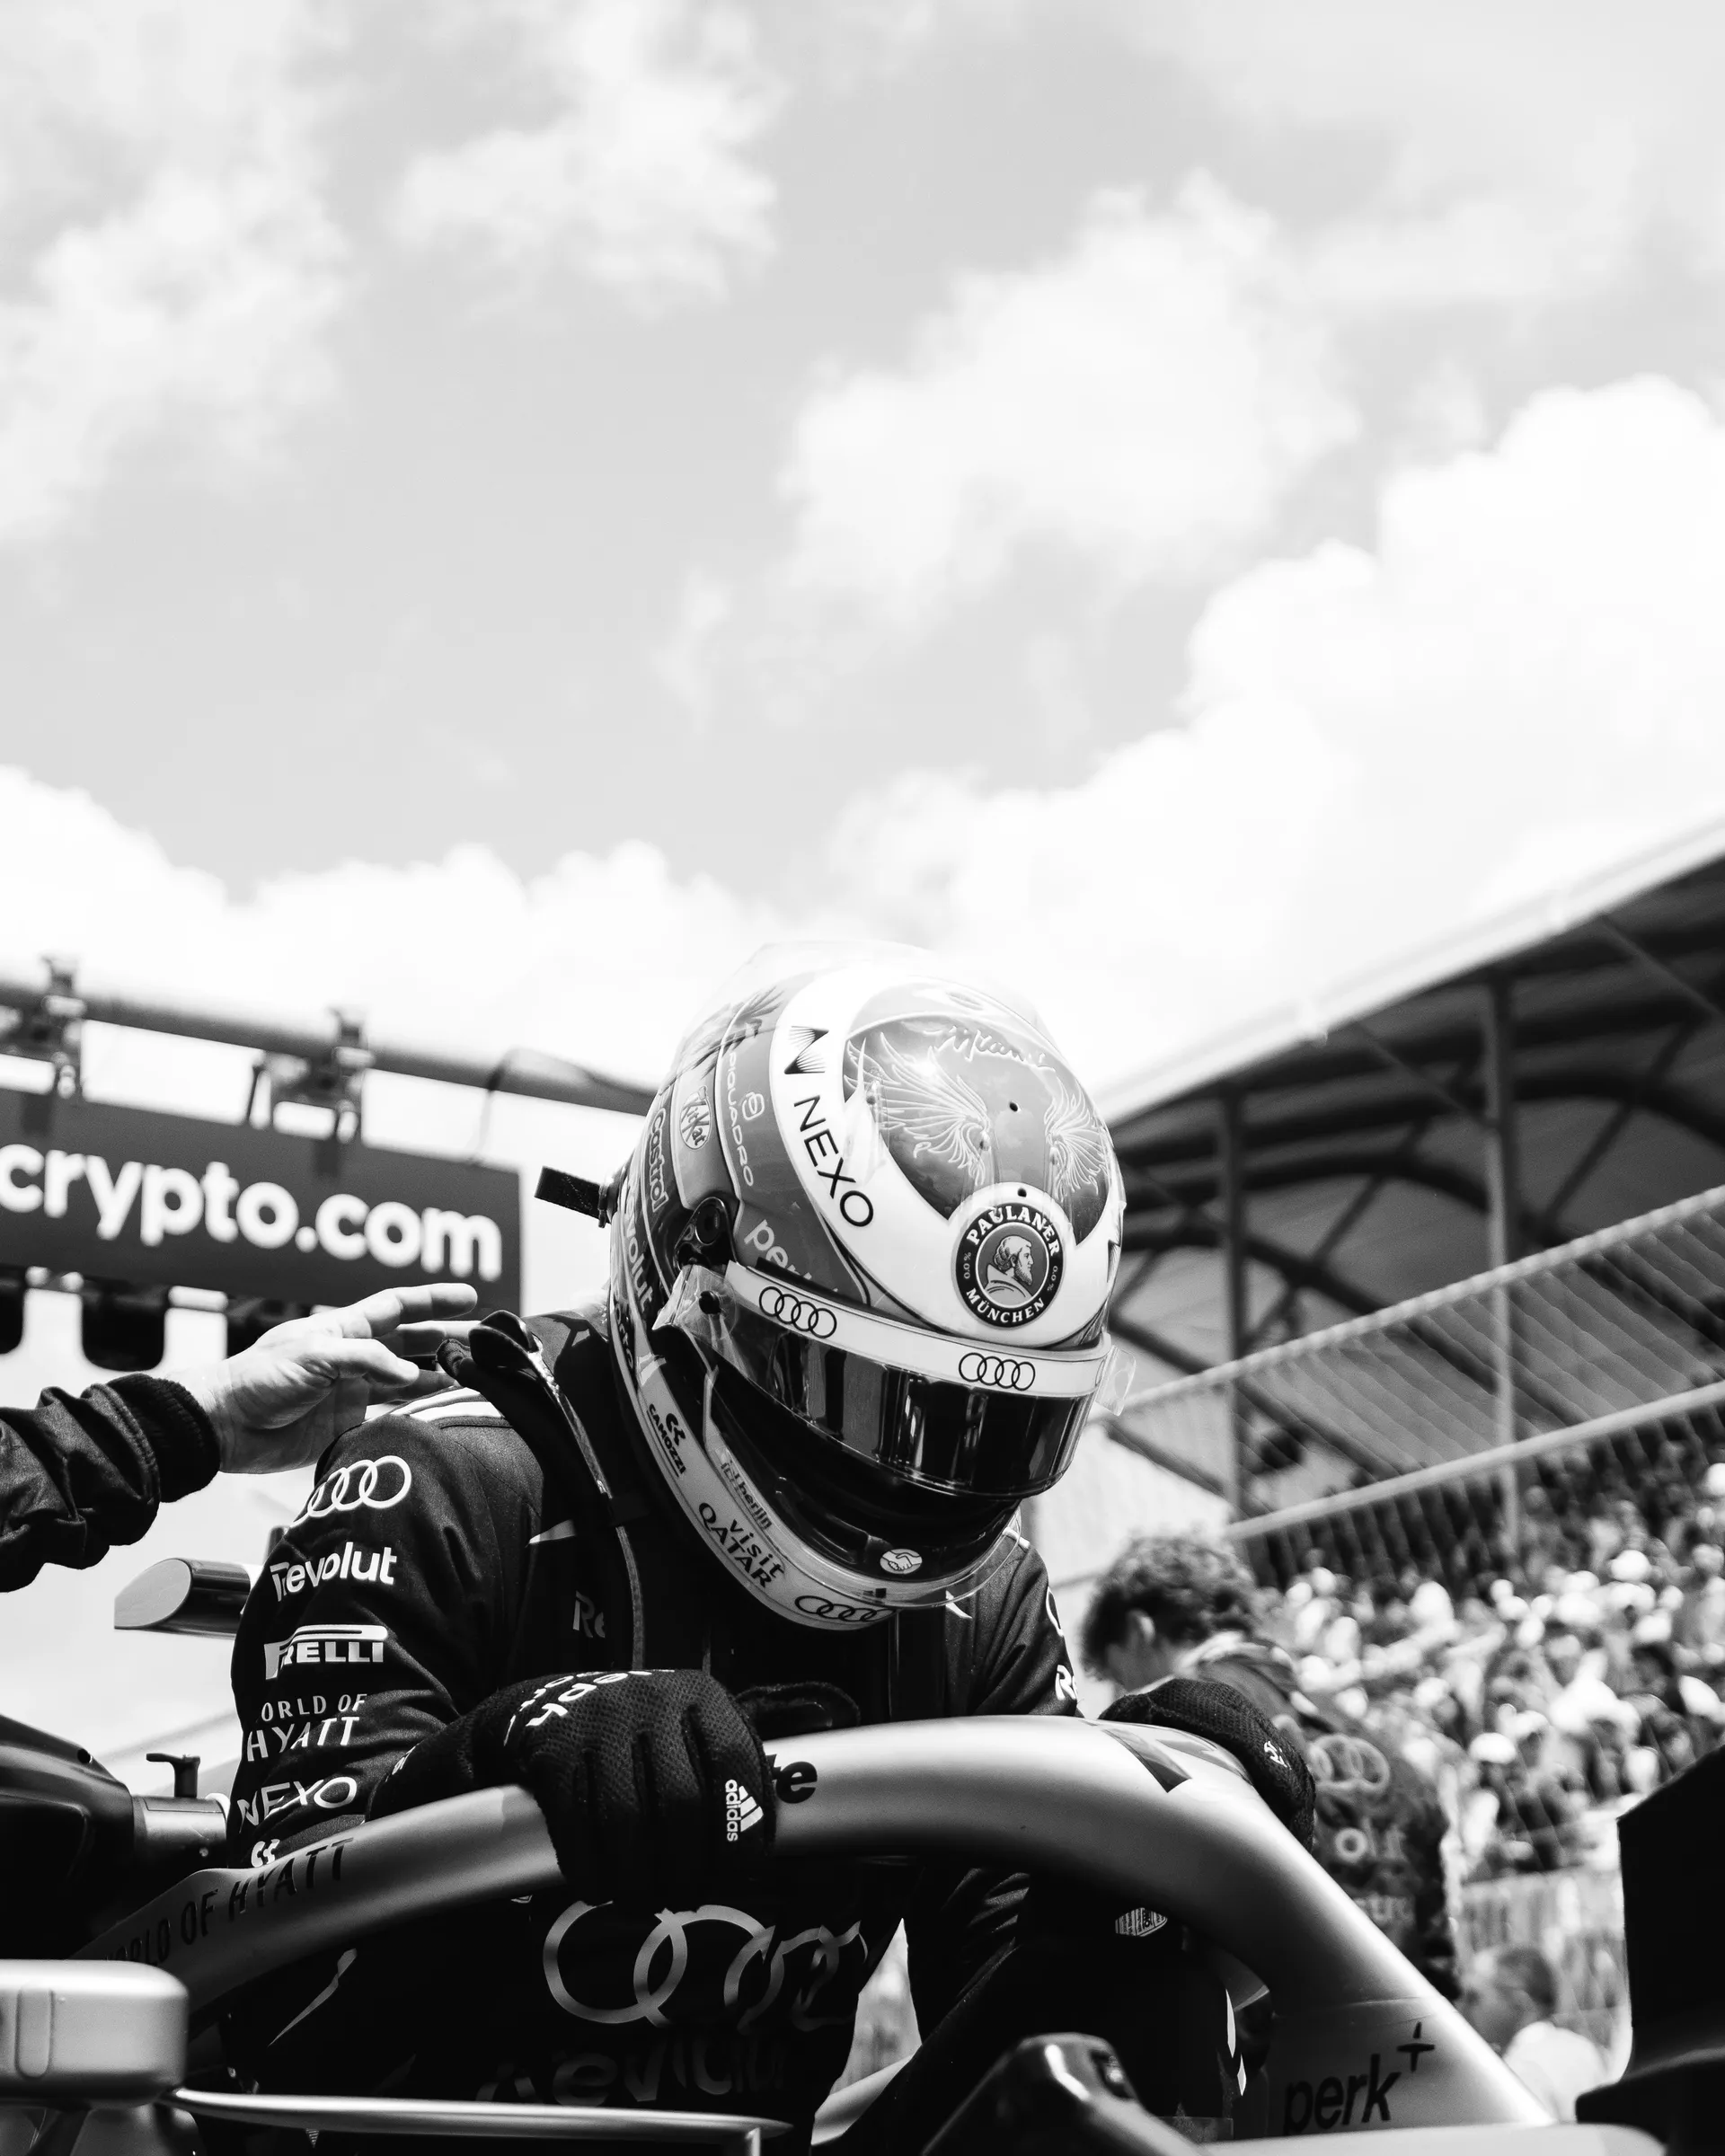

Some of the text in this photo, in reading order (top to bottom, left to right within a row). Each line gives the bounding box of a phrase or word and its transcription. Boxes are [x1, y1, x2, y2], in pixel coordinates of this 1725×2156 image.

[646, 1108, 669, 1213] Castrol
[793, 1094, 874, 1227] NEXO
[0, 1144, 503, 1282] crypto.com
[966, 1205, 1062, 1257] PAULANER
[966, 1286, 1046, 1324] MÜNCHEN
[649, 1403, 686, 1474] CAMOZZI
[698, 1502, 773, 1588] QATAR
[730, 1518, 785, 1578] visit
[263, 1624, 388, 1680] PRELLI
[261, 1693, 367, 1722] ORLD OF
[247, 1716, 360, 1762] HYATT
[237, 1776, 358, 1833] NEXO
[724, 1779, 739, 1842] adidas
[180, 1888, 219, 1946] OF
[228, 1837, 355, 1922] HYATT
